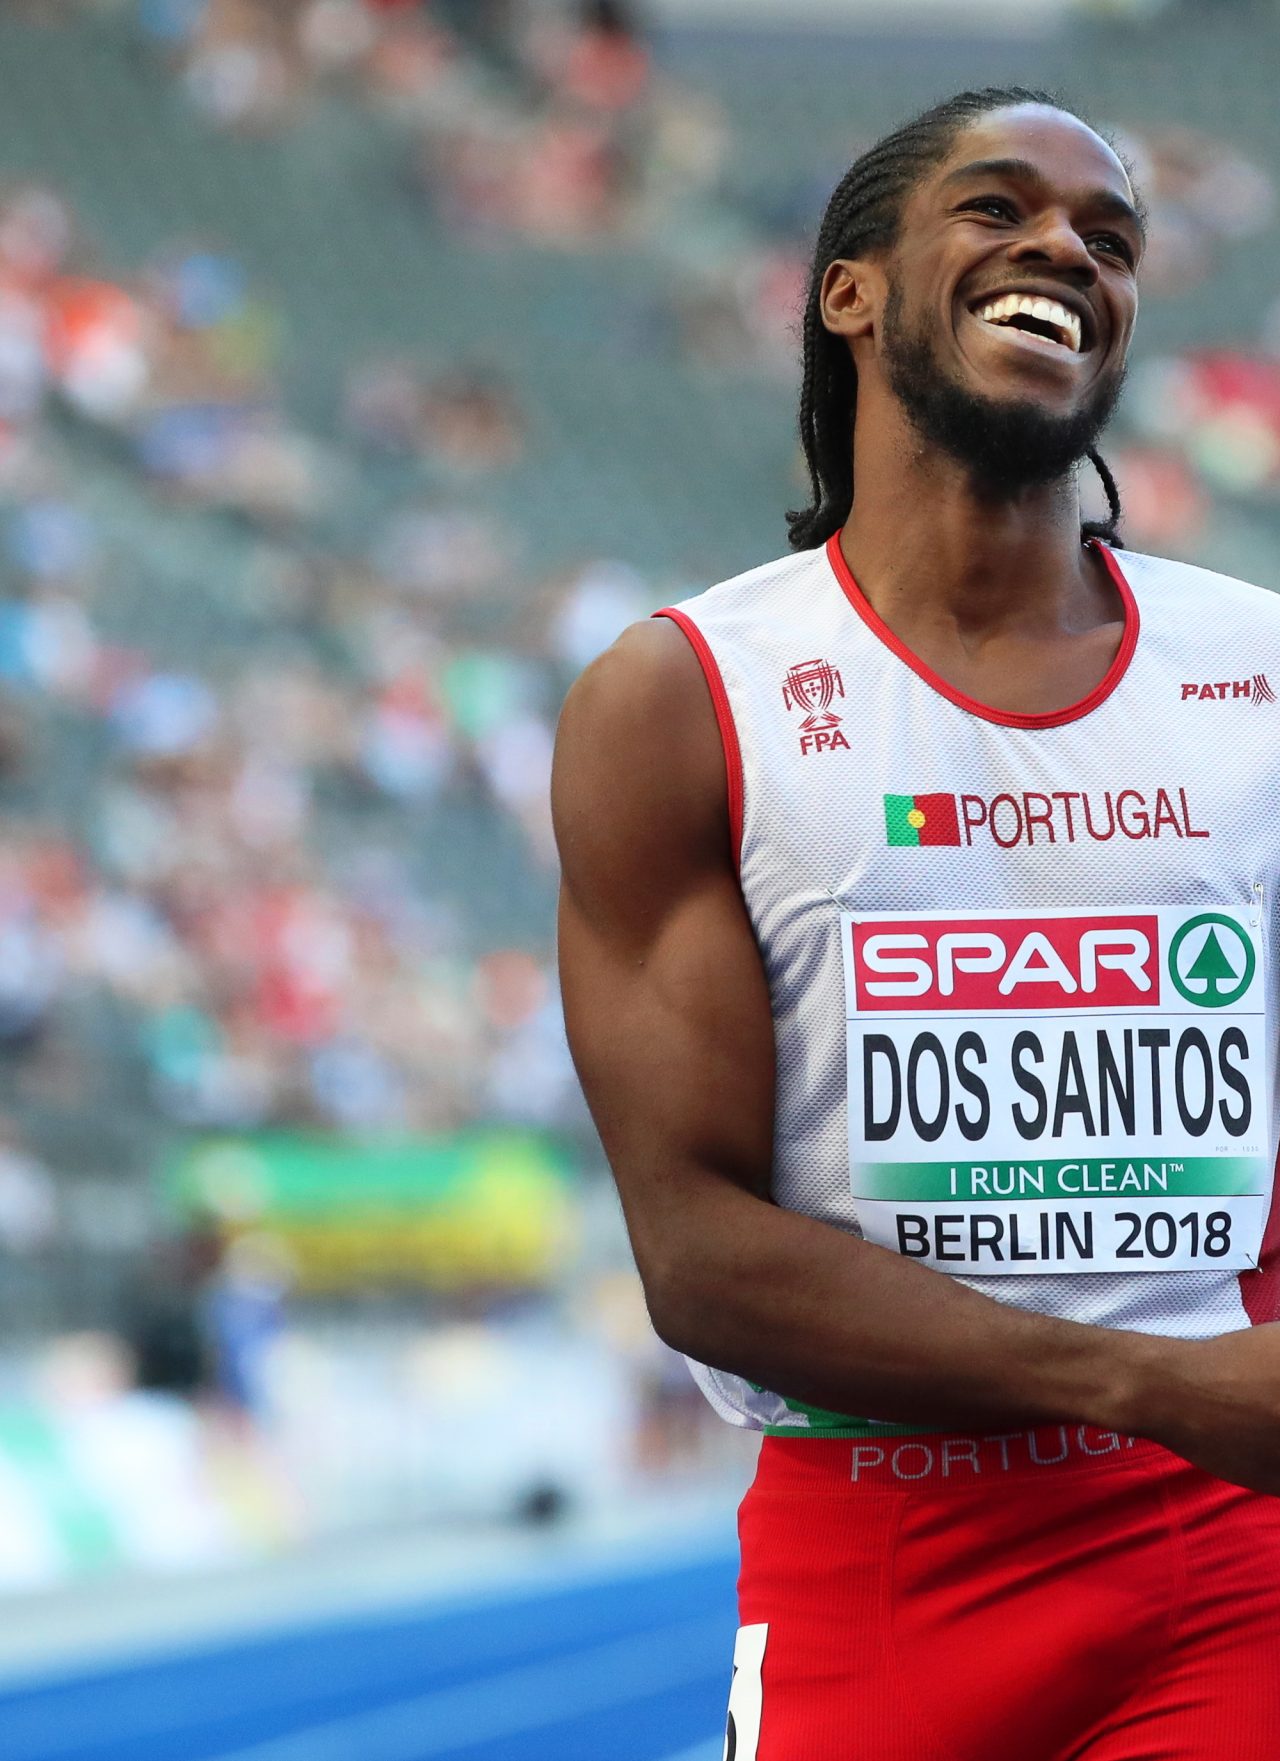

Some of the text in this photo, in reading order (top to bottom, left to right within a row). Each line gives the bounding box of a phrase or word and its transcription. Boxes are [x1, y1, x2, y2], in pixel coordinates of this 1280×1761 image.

[799, 730, 851, 756] FPA
[960, 787, 1210, 849] PORTUGAL
[862, 929, 1152, 998] SPAR
[863, 1026, 1252, 1143] DOS SANTOS
[950, 1167, 957, 1196] I
[970, 1165, 1045, 1195] RUN
[896, 1210, 1232, 1262] BERLIN 2018
[851, 1425, 1135, 1482] PORTUG
